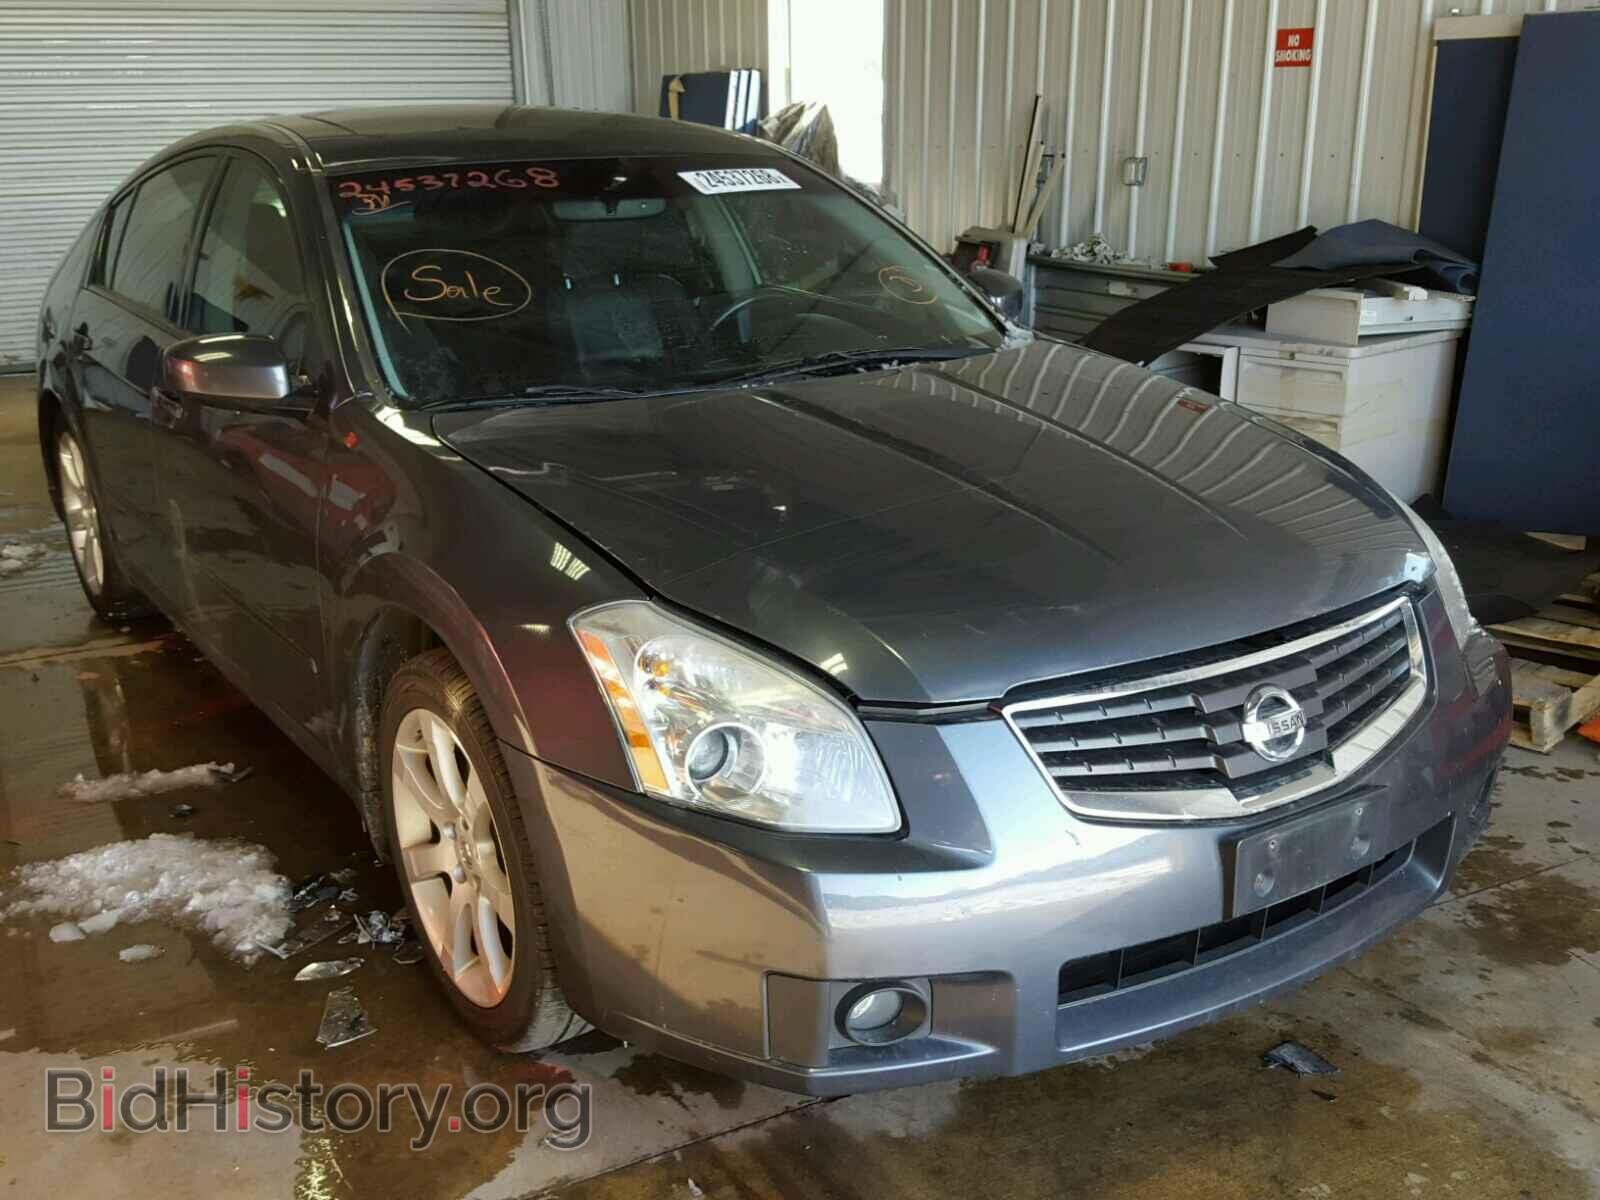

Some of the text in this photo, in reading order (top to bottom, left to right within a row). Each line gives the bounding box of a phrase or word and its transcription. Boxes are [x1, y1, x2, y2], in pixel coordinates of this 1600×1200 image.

[1287, 34, 1300, 47] NO
[1275, 48, 1311, 62] SMOKING
[404, 265, 513, 306] Sale
